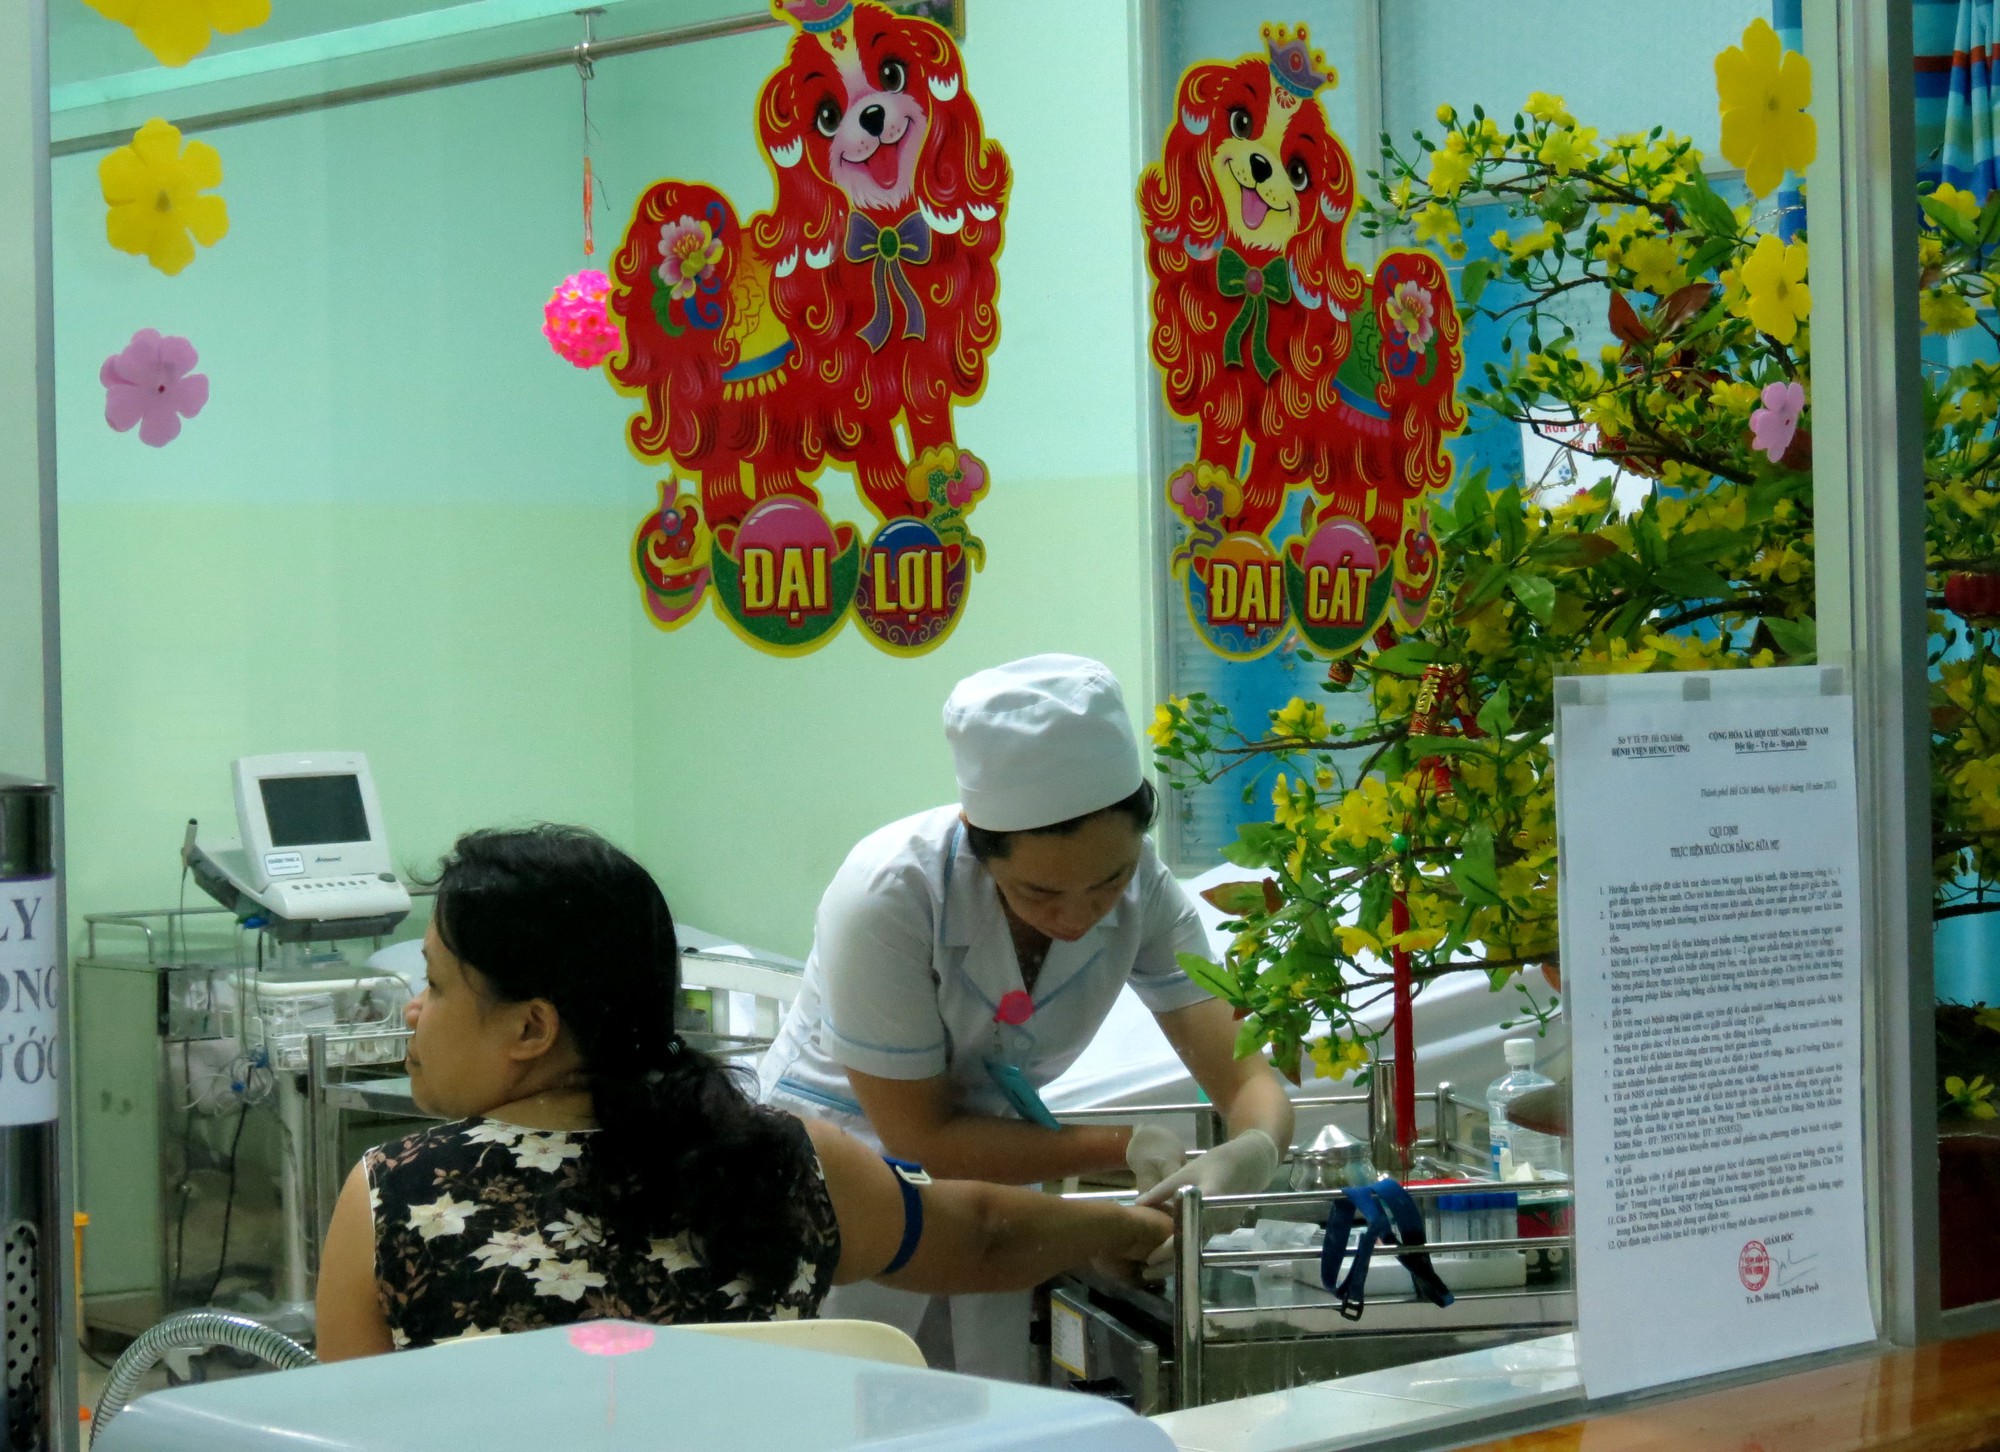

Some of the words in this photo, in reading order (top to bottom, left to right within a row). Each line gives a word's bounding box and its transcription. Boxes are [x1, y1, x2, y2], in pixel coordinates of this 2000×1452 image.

[742, 548, 828, 619] ĐẠI
[873, 549, 944, 622] LỢI
[1210, 563, 1282, 633] ĐẠI
[1307, 555, 1374, 622] CÁT
[0, 897, 42, 941] Y
